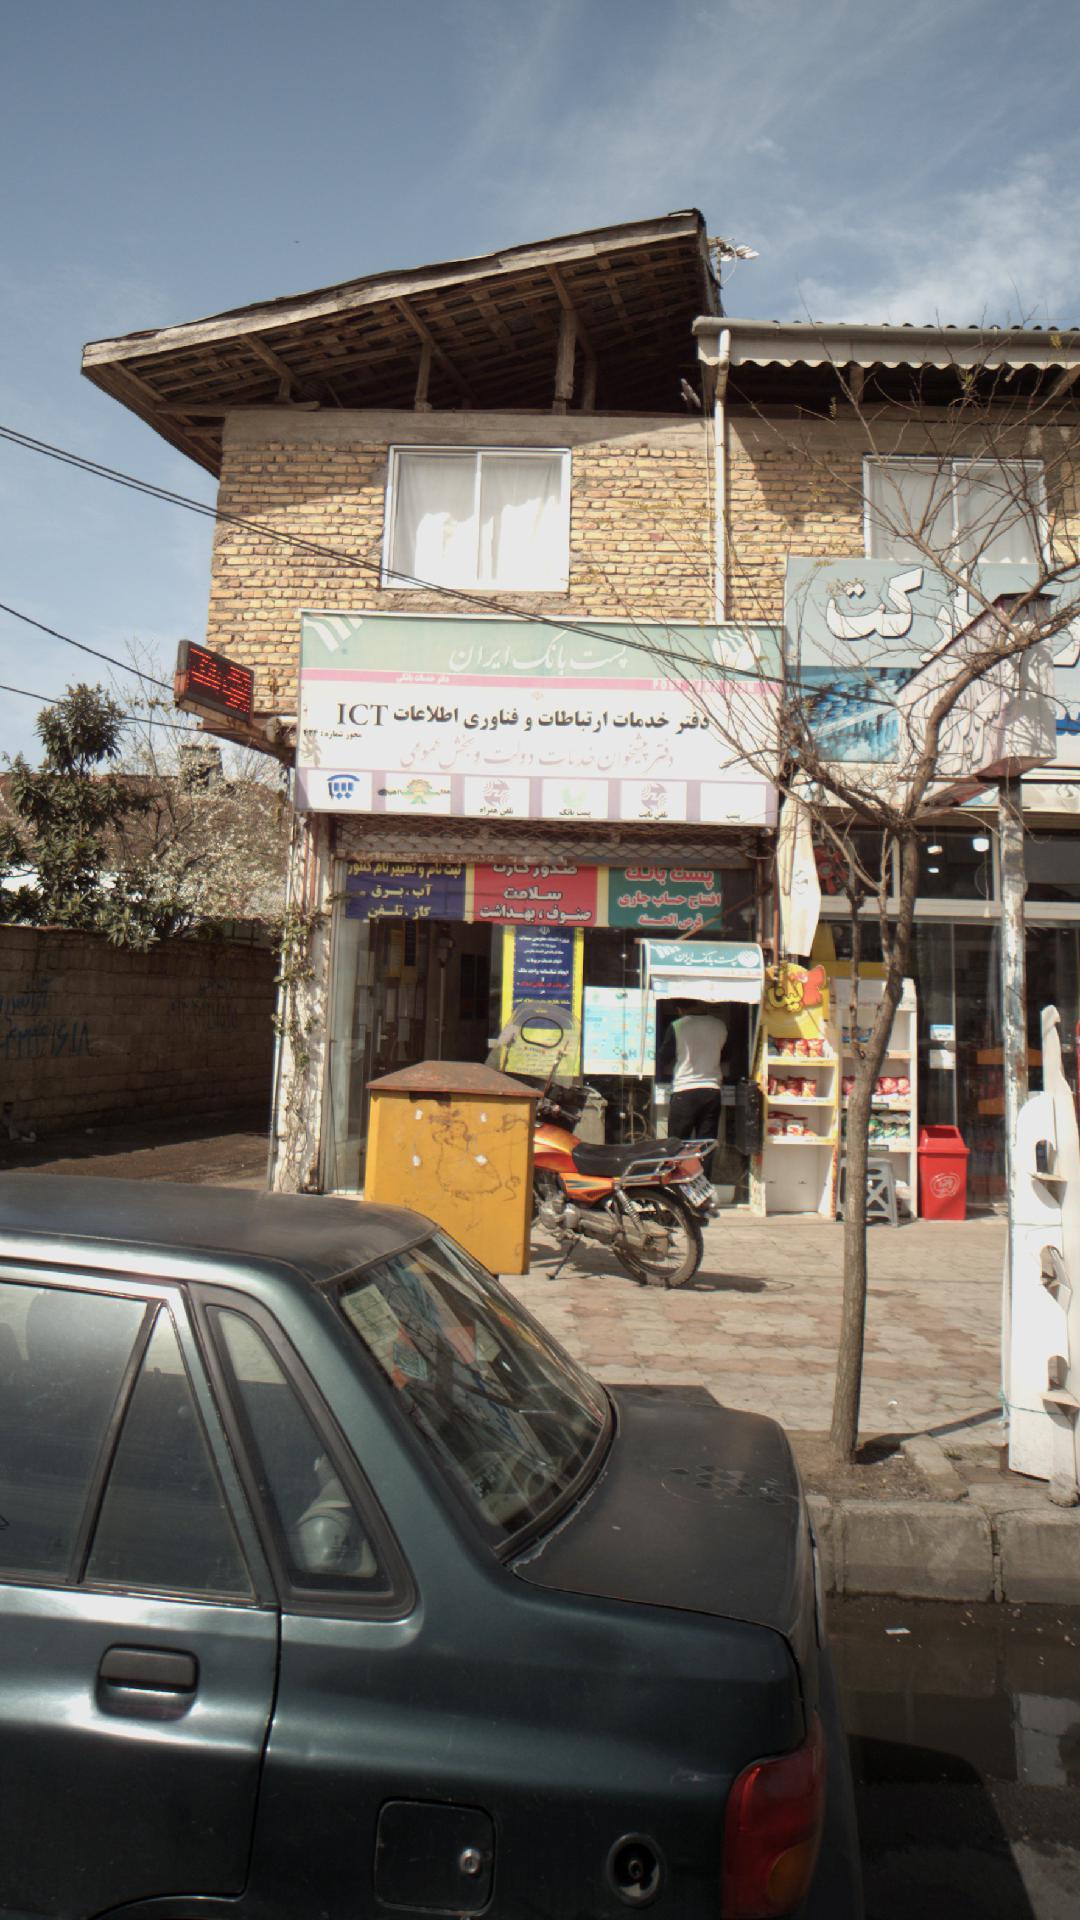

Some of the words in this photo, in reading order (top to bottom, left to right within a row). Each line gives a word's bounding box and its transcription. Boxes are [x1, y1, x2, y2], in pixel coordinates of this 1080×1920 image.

[448, 645, 511, 672] ایران
[511, 629, 568, 676] بانک
[569, 645, 629, 670] پست
[337, 703, 389, 727] ICT
[393, 703, 458, 723] اطلاعات
[463, 707, 519, 731] فناوری
[523, 716, 533, 731] و
[538, 709, 608, 733] ارتباطات
[612, 711, 669, 729] خدمات
[675, 711, 710, 734] دفتر
[483, 738, 534, 765] دولت
[538, 746, 594, 766] خدمات
[532, 864, 578, 878] صدور
[624, 865, 667, 886] بانک
[669, 866, 714, 890] پست
[503, 885, 563, 901] سلامت
[618, 890, 651, 908] جاری
[480, 904, 536, 923] بهداشت
[546, 905, 592, 924] صنوف
